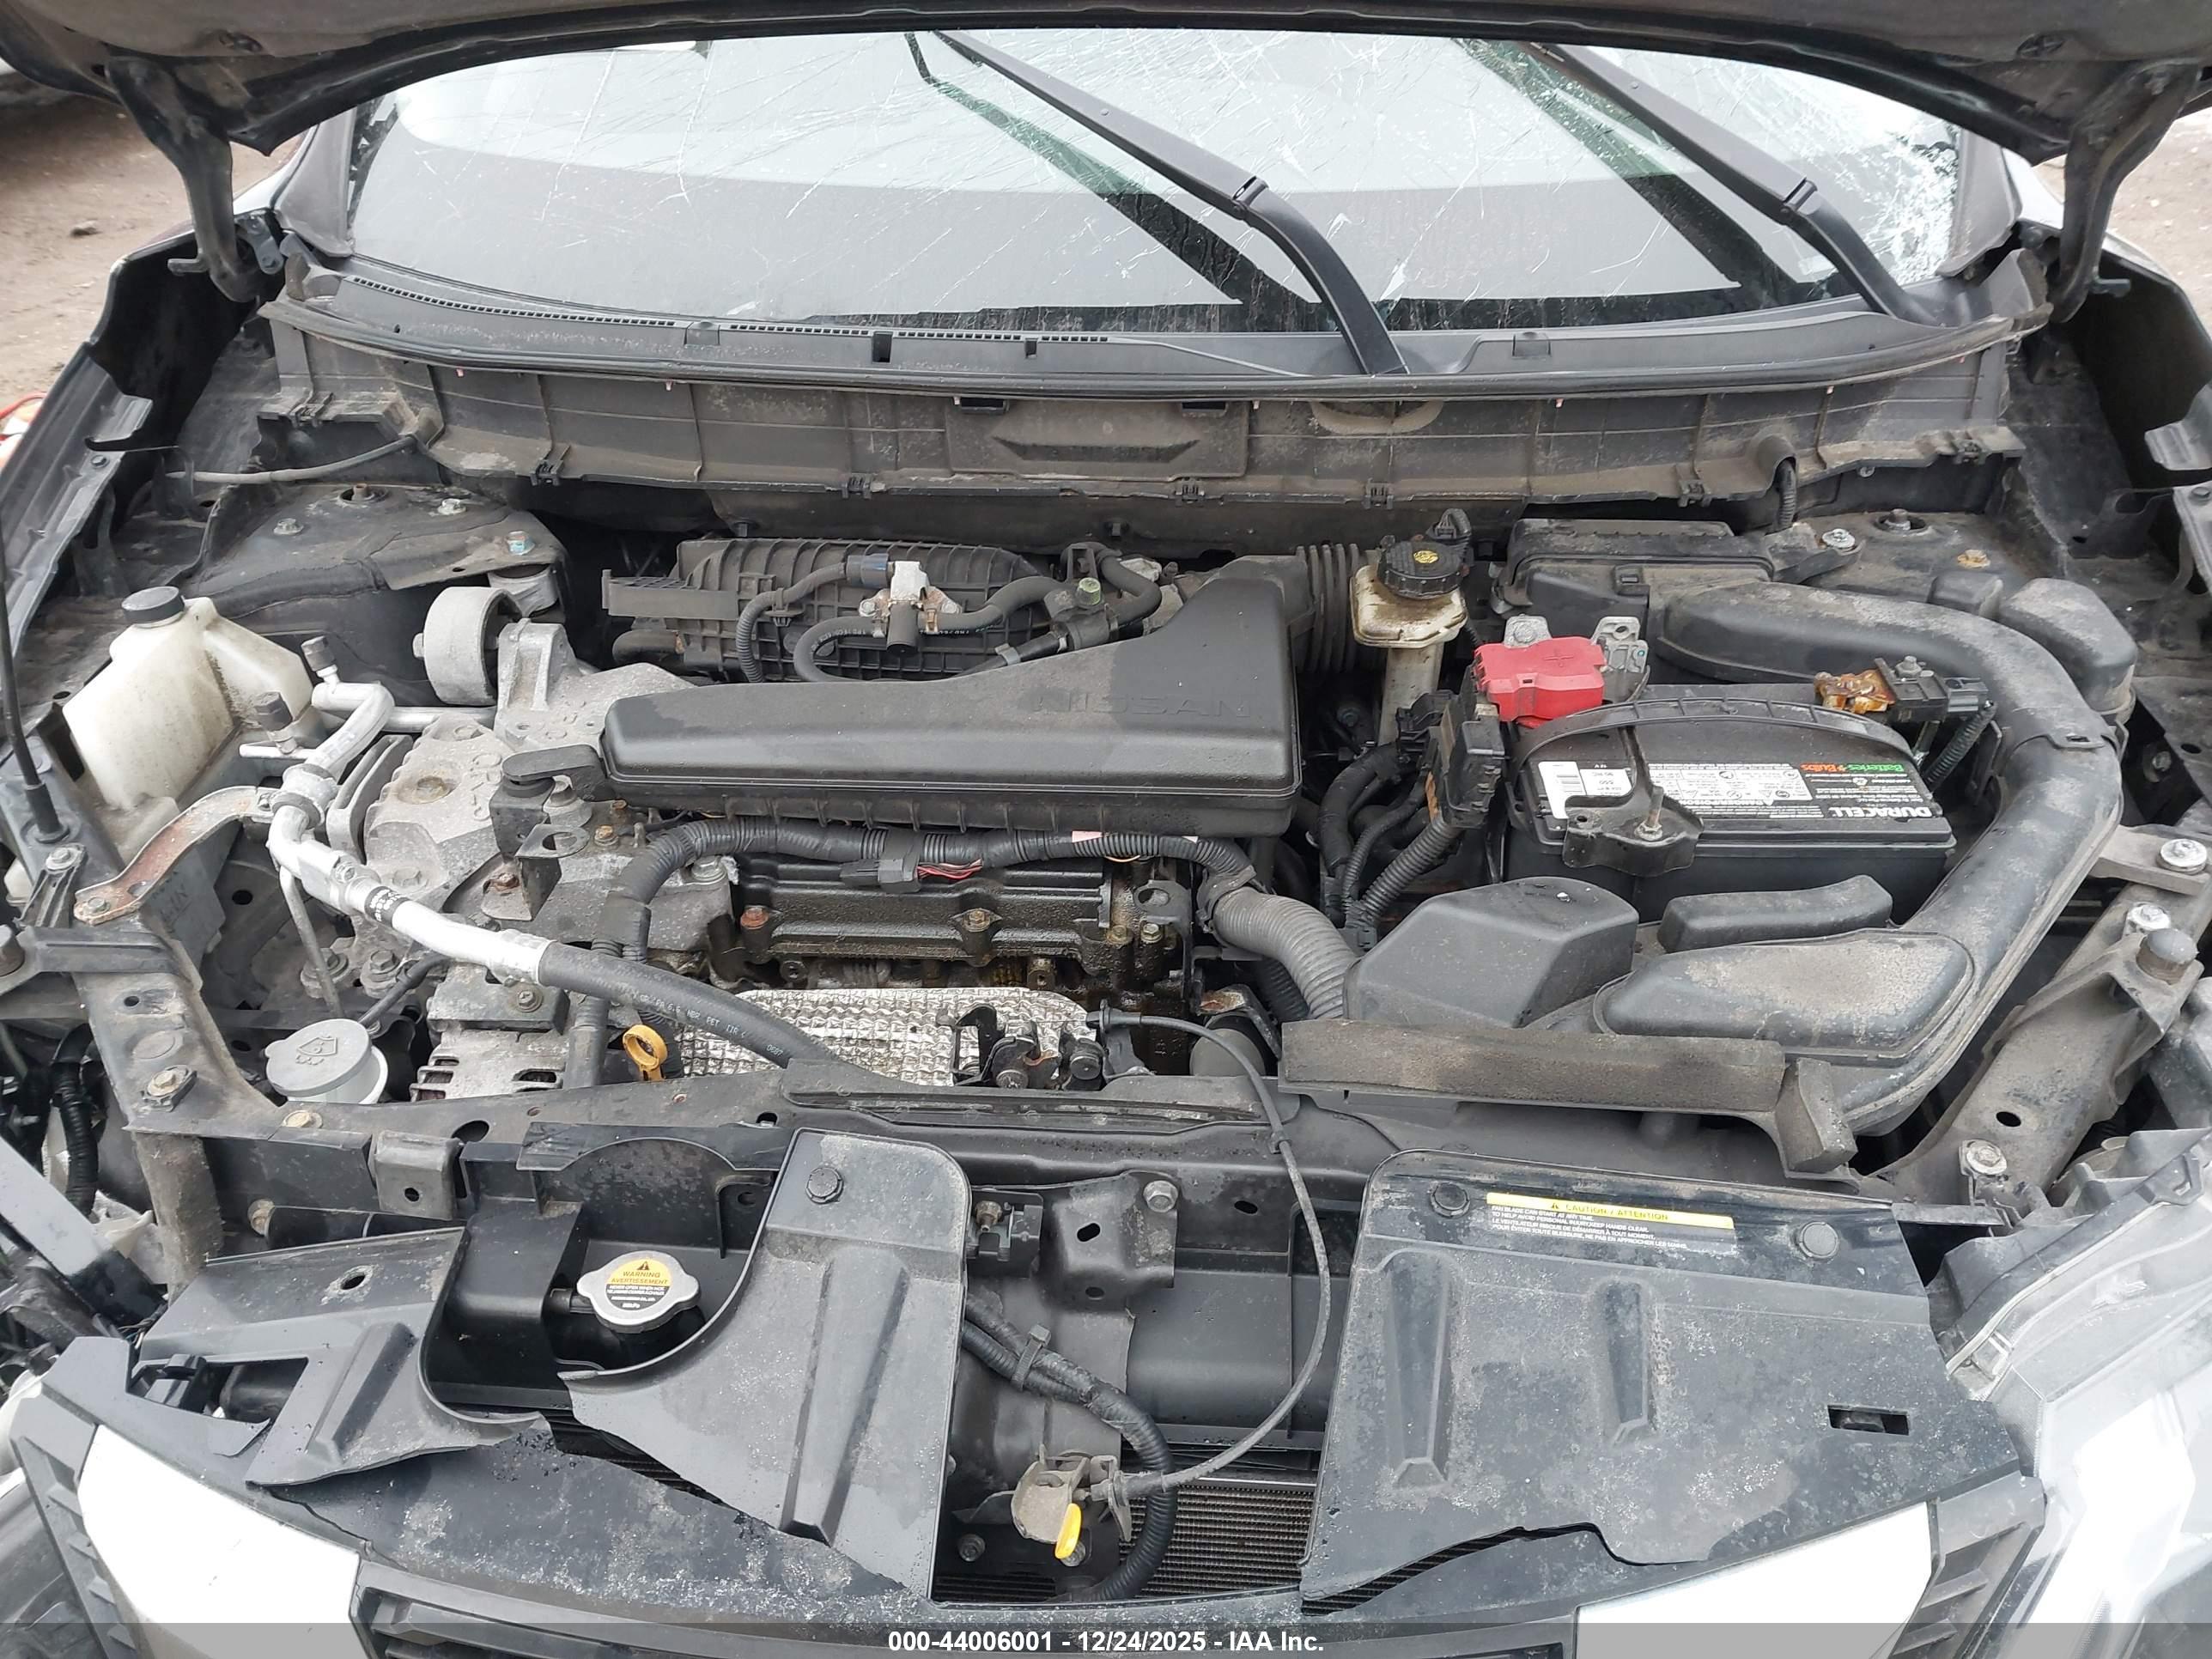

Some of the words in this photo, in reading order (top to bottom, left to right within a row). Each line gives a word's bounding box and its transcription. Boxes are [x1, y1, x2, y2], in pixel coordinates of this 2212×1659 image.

[1801, 763, 1837, 772] Bulbs
[1847, 763, 1905, 772] Batteries
[1829, 807, 1931, 817] DURACELL
[706, 1017, 720, 1027] PET
[1565, 1205, 1607, 1214] CAUTION
[1618, 1210, 1668, 1220] ATTENTION
[1536, 1216, 1568, 1224] PERSONAL
